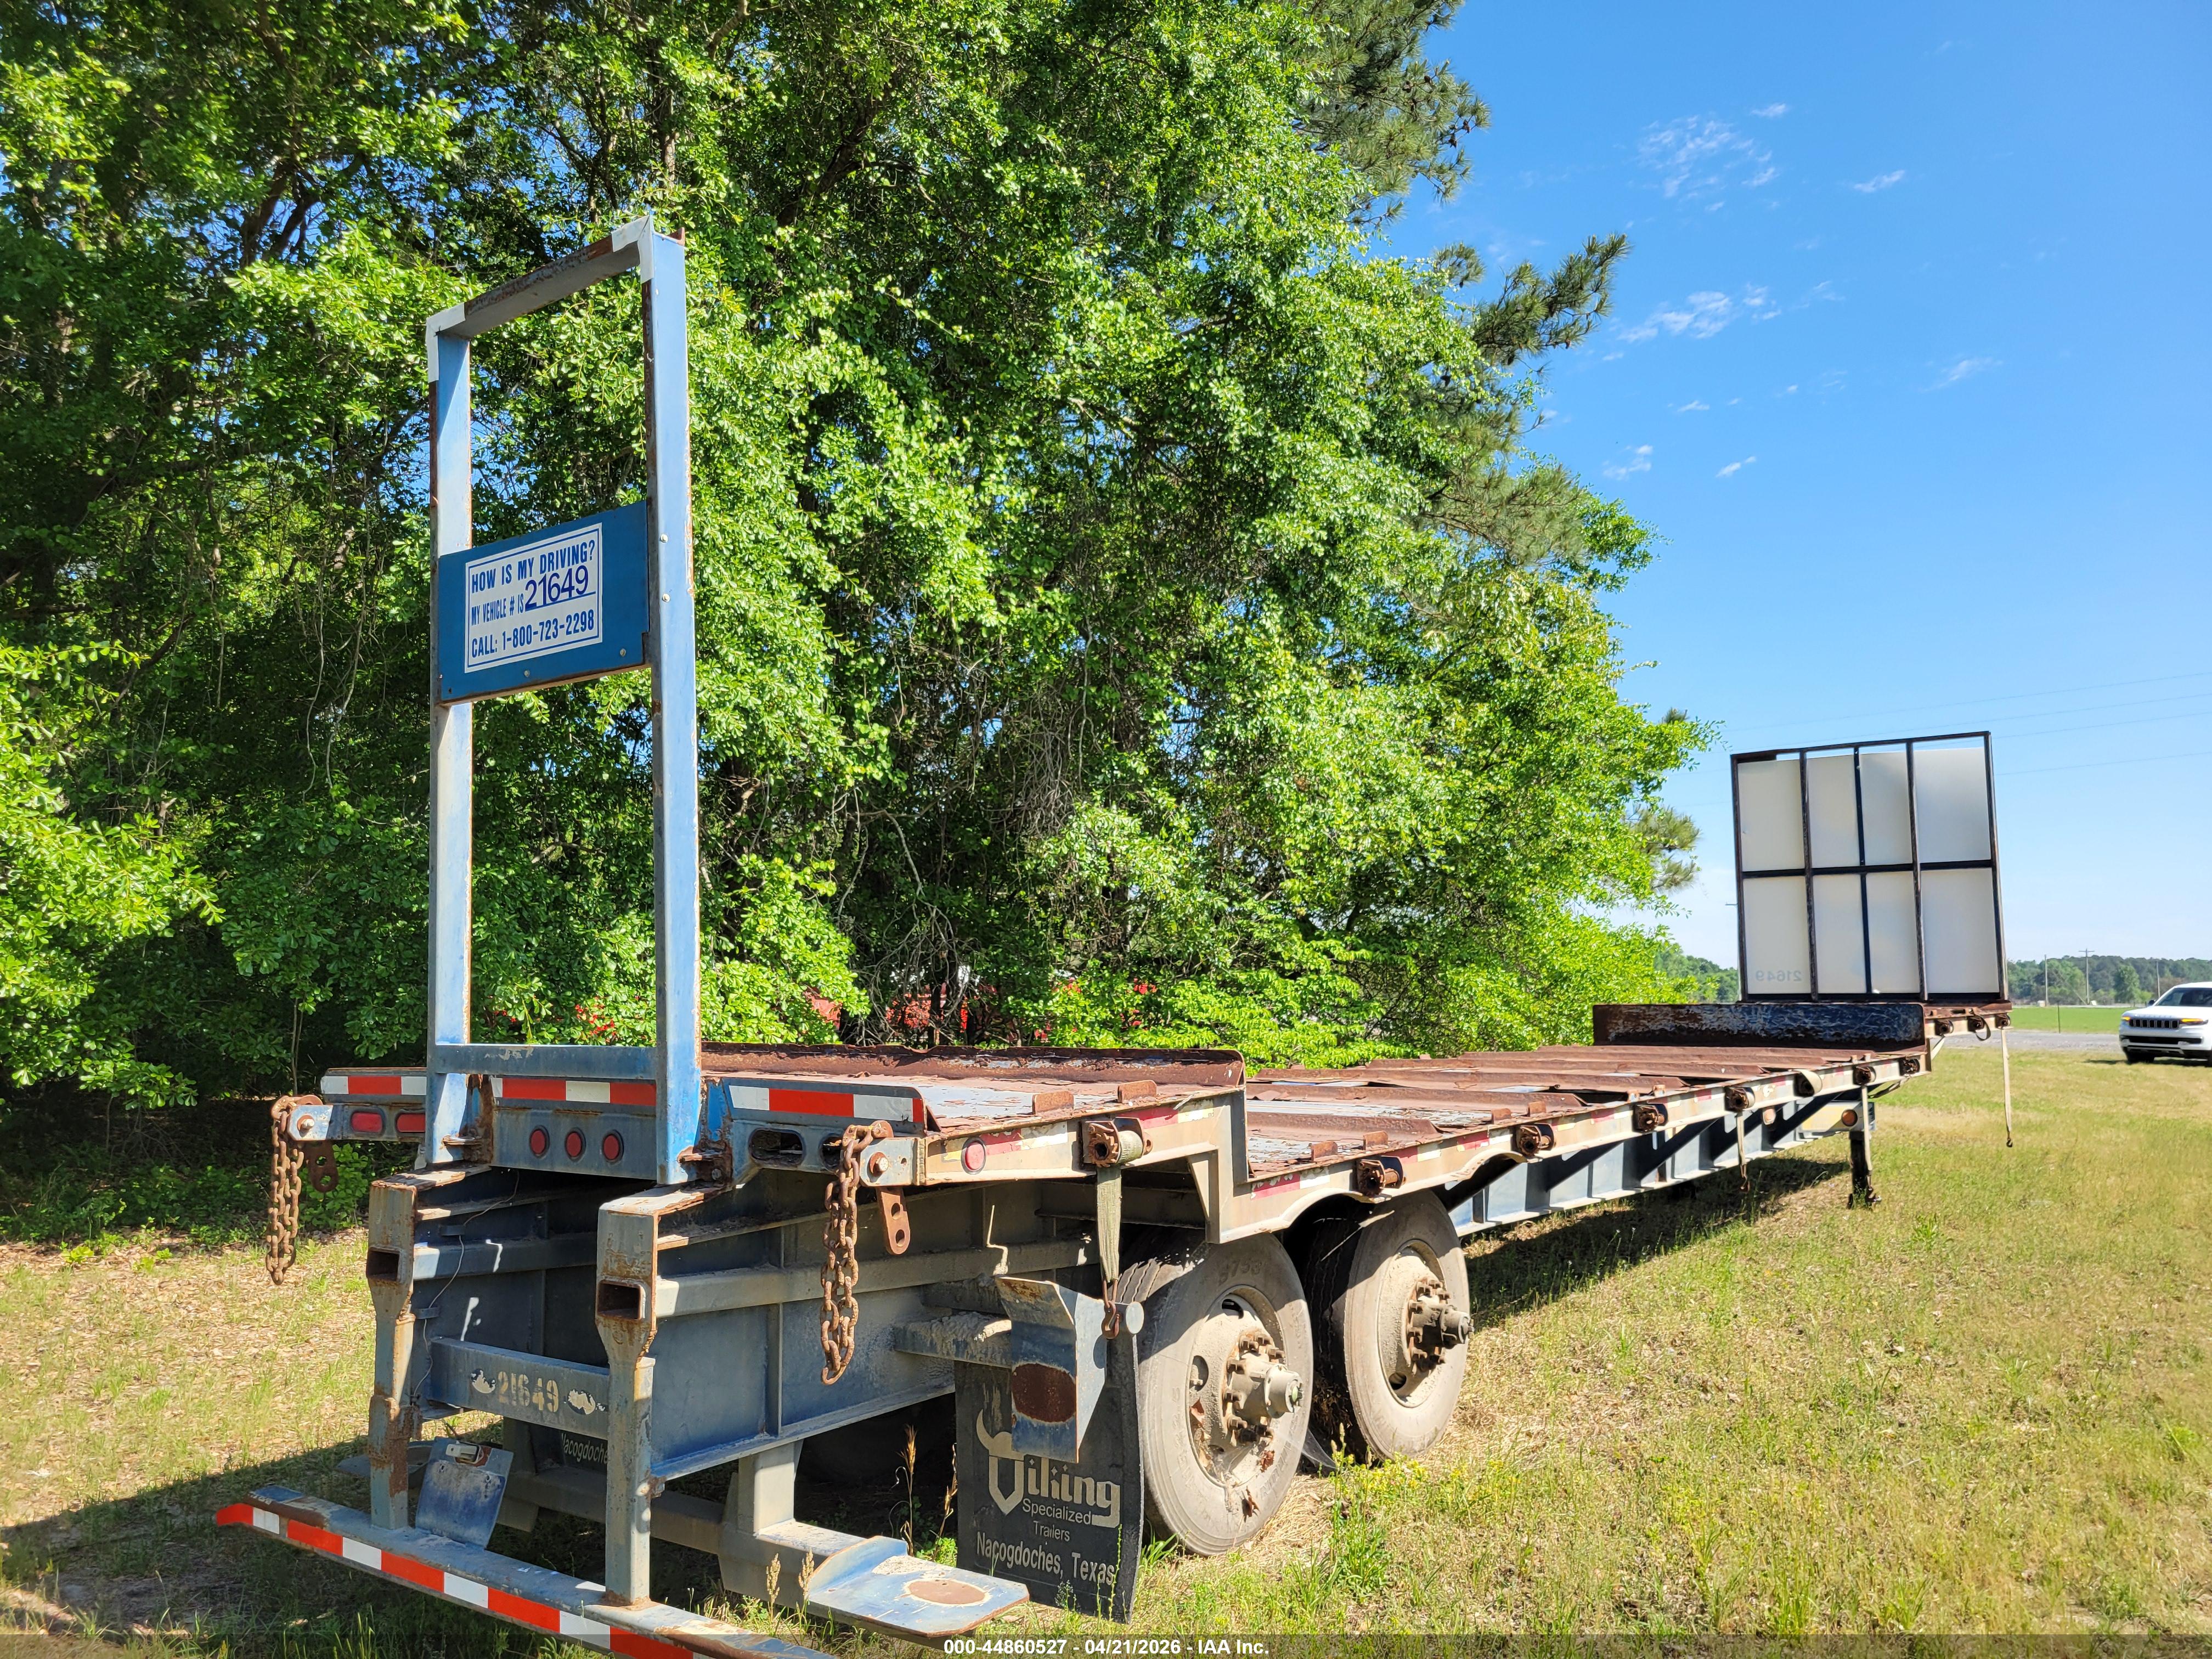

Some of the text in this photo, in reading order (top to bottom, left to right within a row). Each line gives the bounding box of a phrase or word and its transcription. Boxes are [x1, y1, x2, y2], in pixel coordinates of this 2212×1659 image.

[472, 539, 595, 594] HOW IS MY DRIVING?
[471, 565, 589, 625] MY VEHICLE # IS 21649
[472, 609, 594, 658] CALL: 1-800-723-2298
[497, 1371, 560, 1413] 21649
[989, 1454, 1120, 1528] Viking
[1022, 1498, 1091, 1525] Specialized
[1033, 1520, 1070, 1542] Trailers
[977, 1531, 1115, 1586] Nacogdoches, Texas
